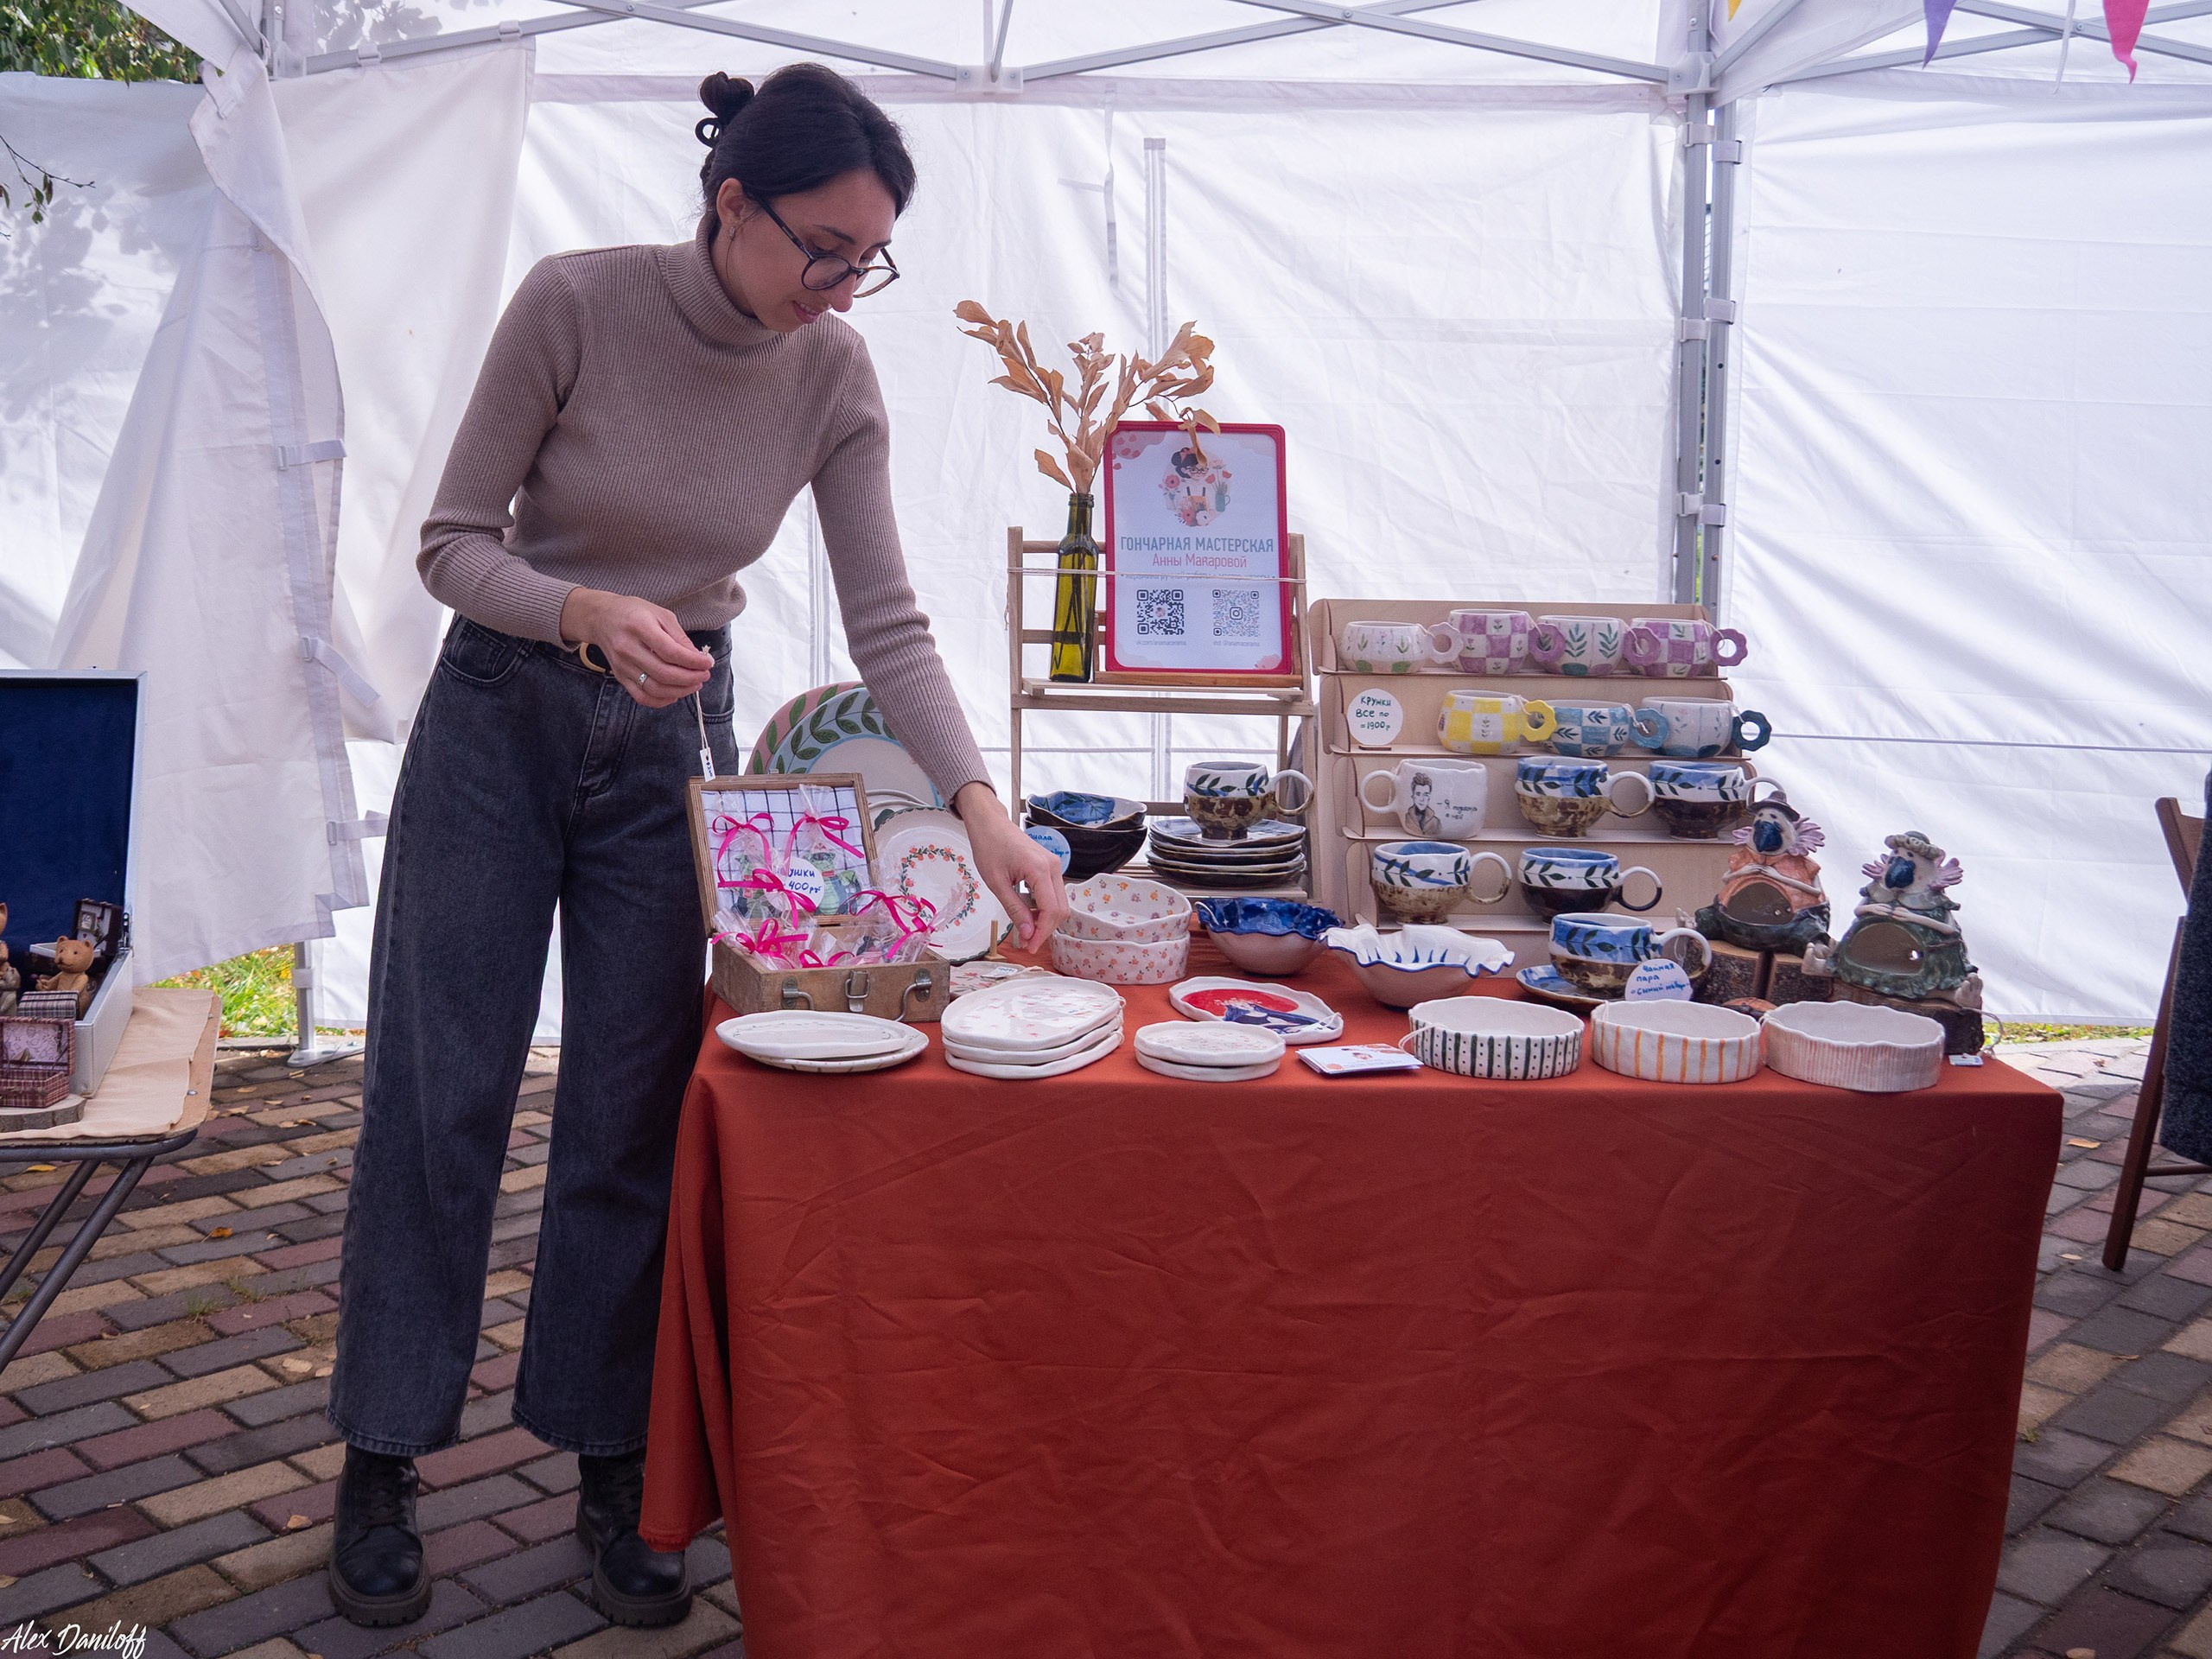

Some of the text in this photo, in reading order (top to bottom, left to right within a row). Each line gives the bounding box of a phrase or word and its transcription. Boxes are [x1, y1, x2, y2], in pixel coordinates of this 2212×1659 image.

[1121, 536, 1274, 553] ГОНЧАРНАЯ МАСТЕРСКАЯ
[1152, 553, 1247, 570] Анны Макаровой
